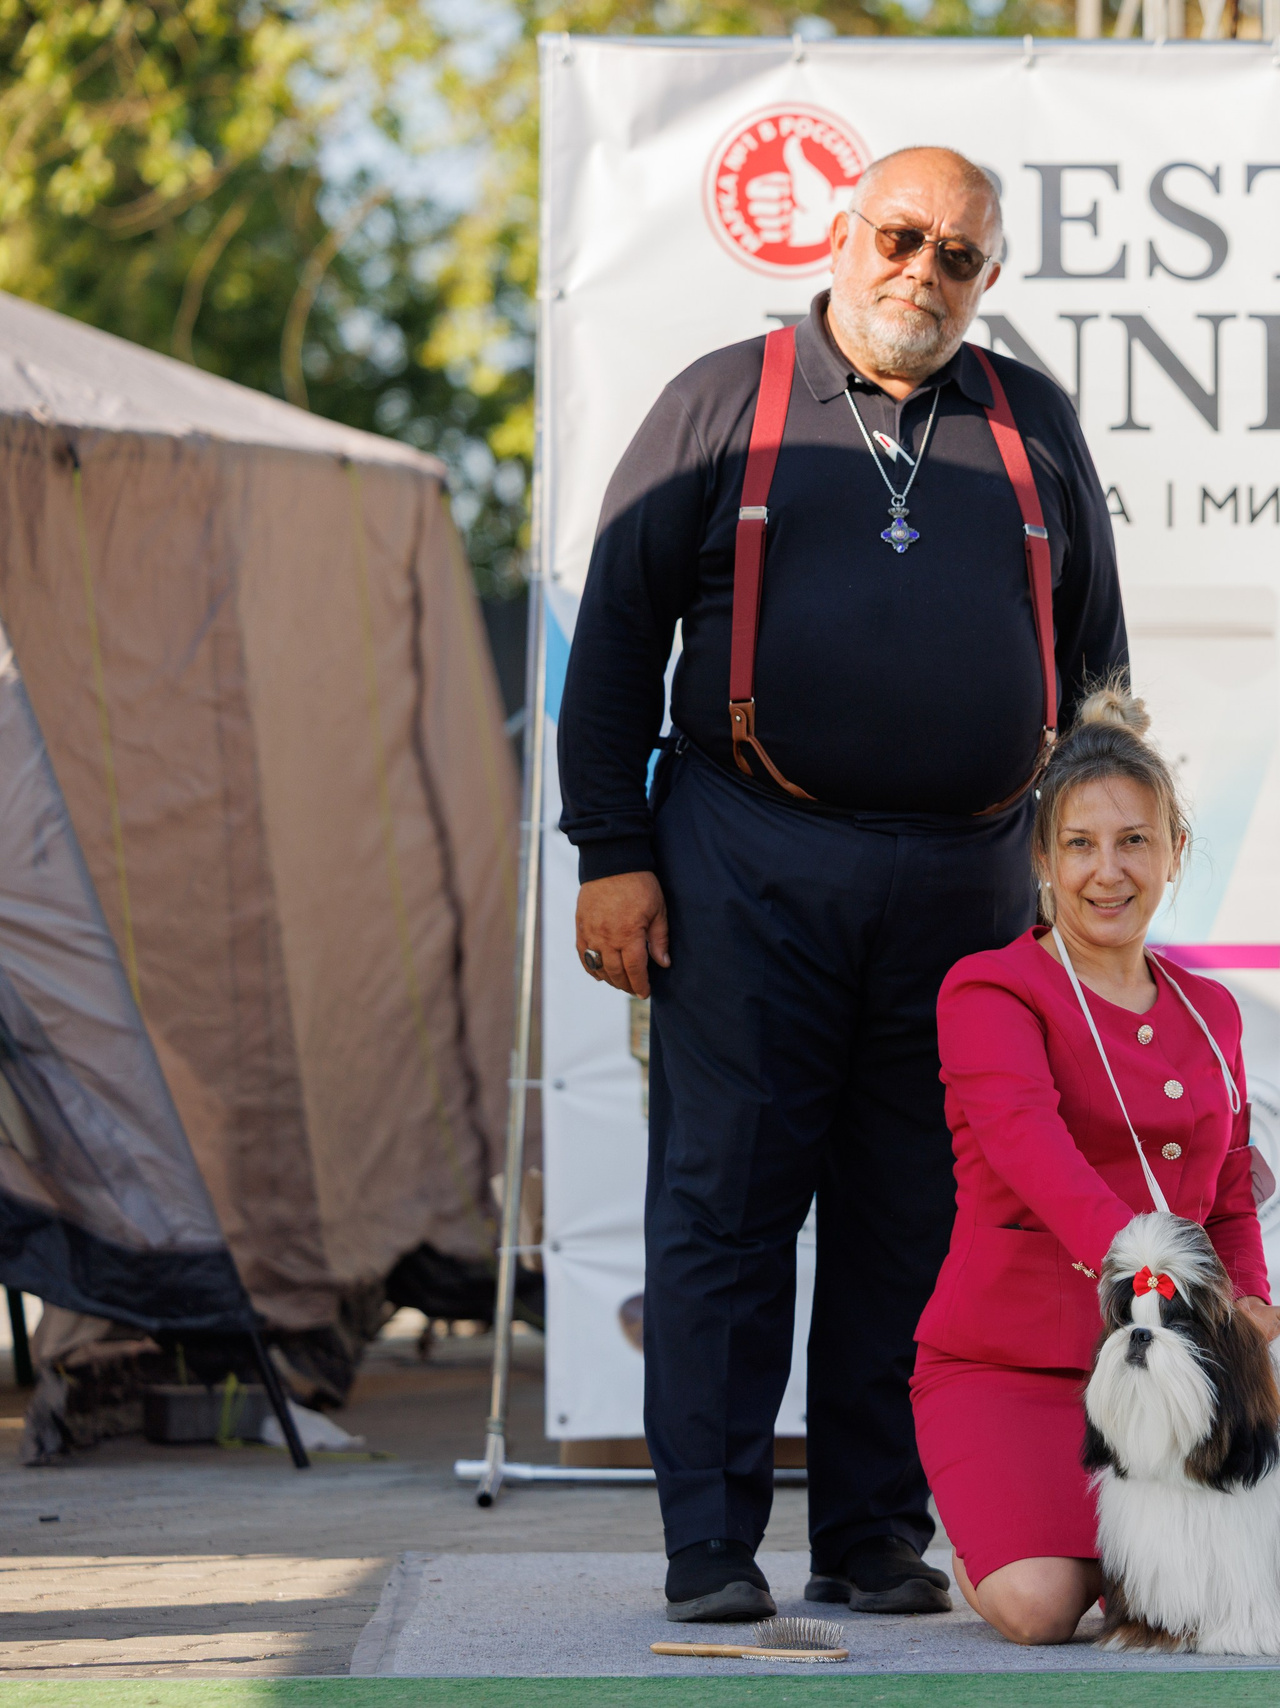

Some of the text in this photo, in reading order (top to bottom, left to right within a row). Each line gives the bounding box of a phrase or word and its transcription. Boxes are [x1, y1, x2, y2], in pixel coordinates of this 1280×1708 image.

[716, 173, 764, 253] МАРКА
[756, 121, 778, 143] В
[779, 116, 862, 179] РОССИИ
